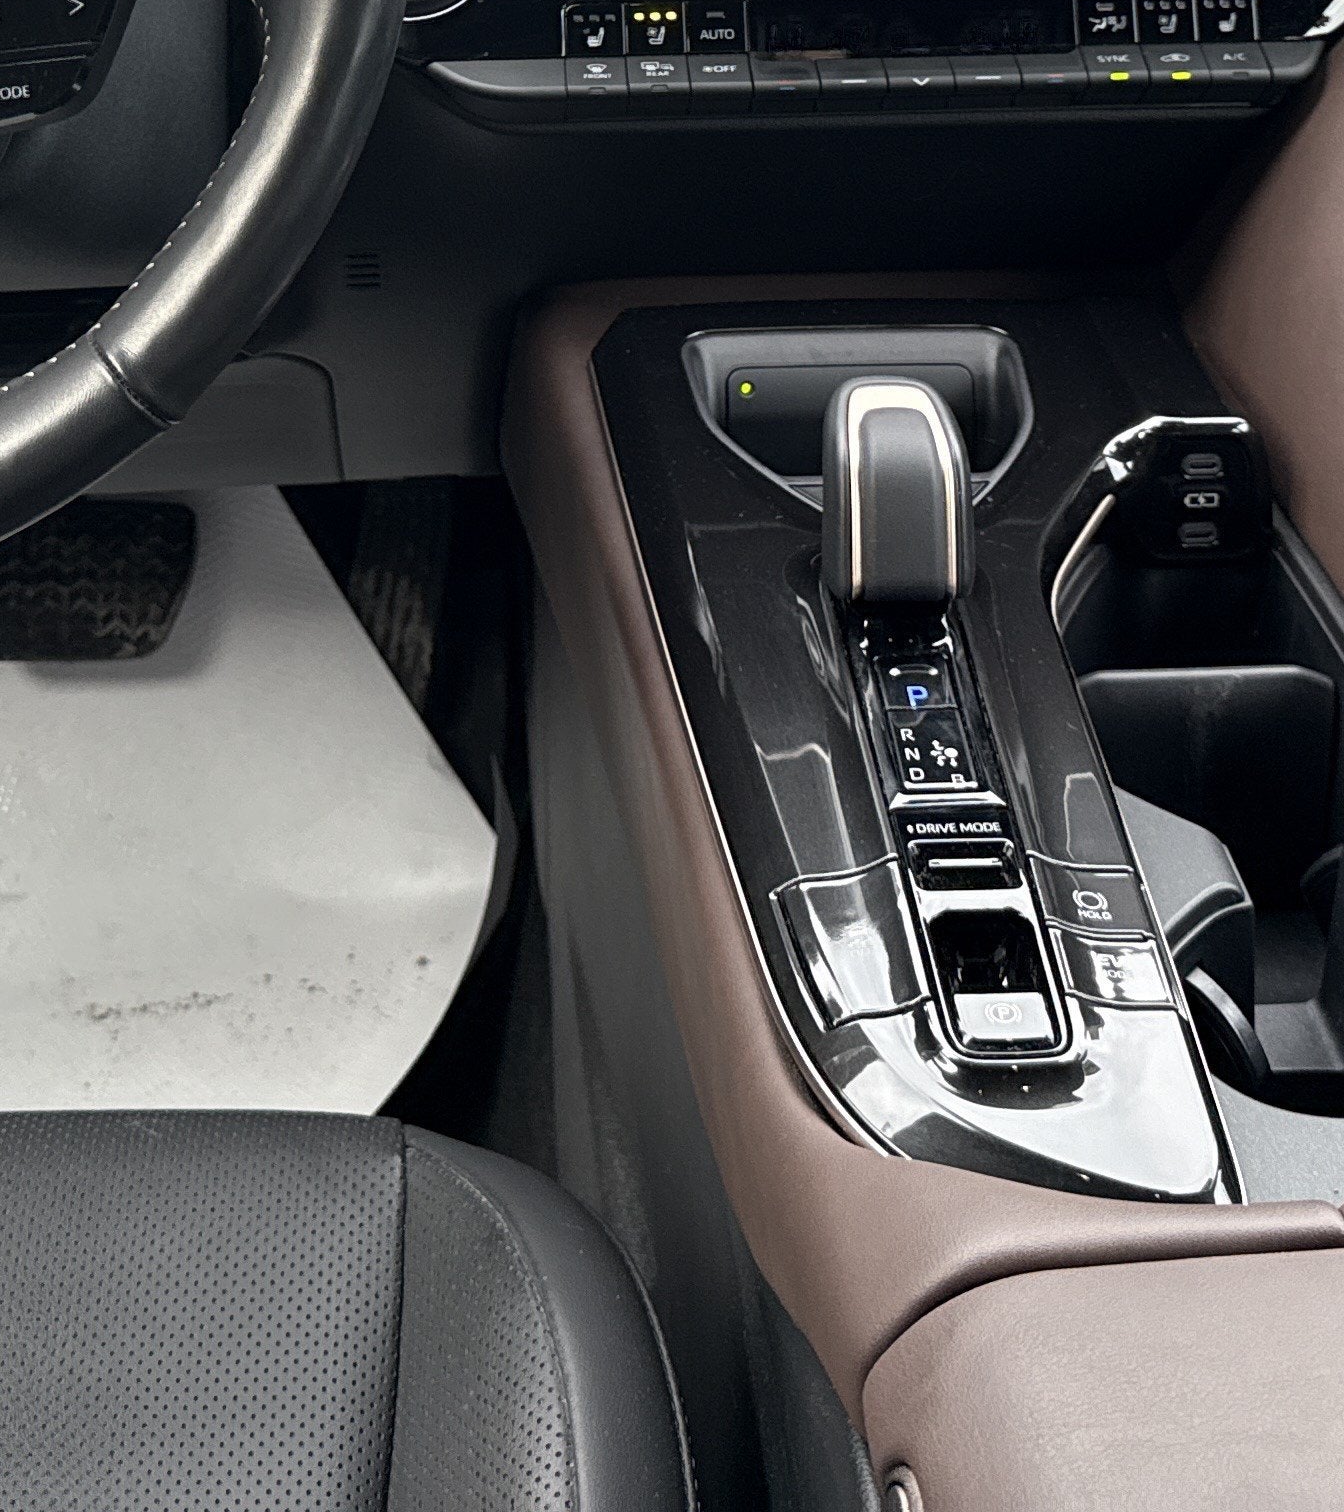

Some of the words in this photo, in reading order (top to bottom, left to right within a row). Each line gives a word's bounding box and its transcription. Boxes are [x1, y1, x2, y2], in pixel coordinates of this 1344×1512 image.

[700, 29, 735, 40] AUTO
[1096, 54, 1131, 63] SYNC
[713, 64, 737, 73] OFF
[906, 685, 929, 710] P
[900, 728, 916, 742] R
[904, 747, 921, 761] N
[908, 767, 925, 781] D
[915, 822, 957, 834] DRIVE
[960, 821, 1002, 833] MODE
[1077, 909, 1113, 921] HOLD
